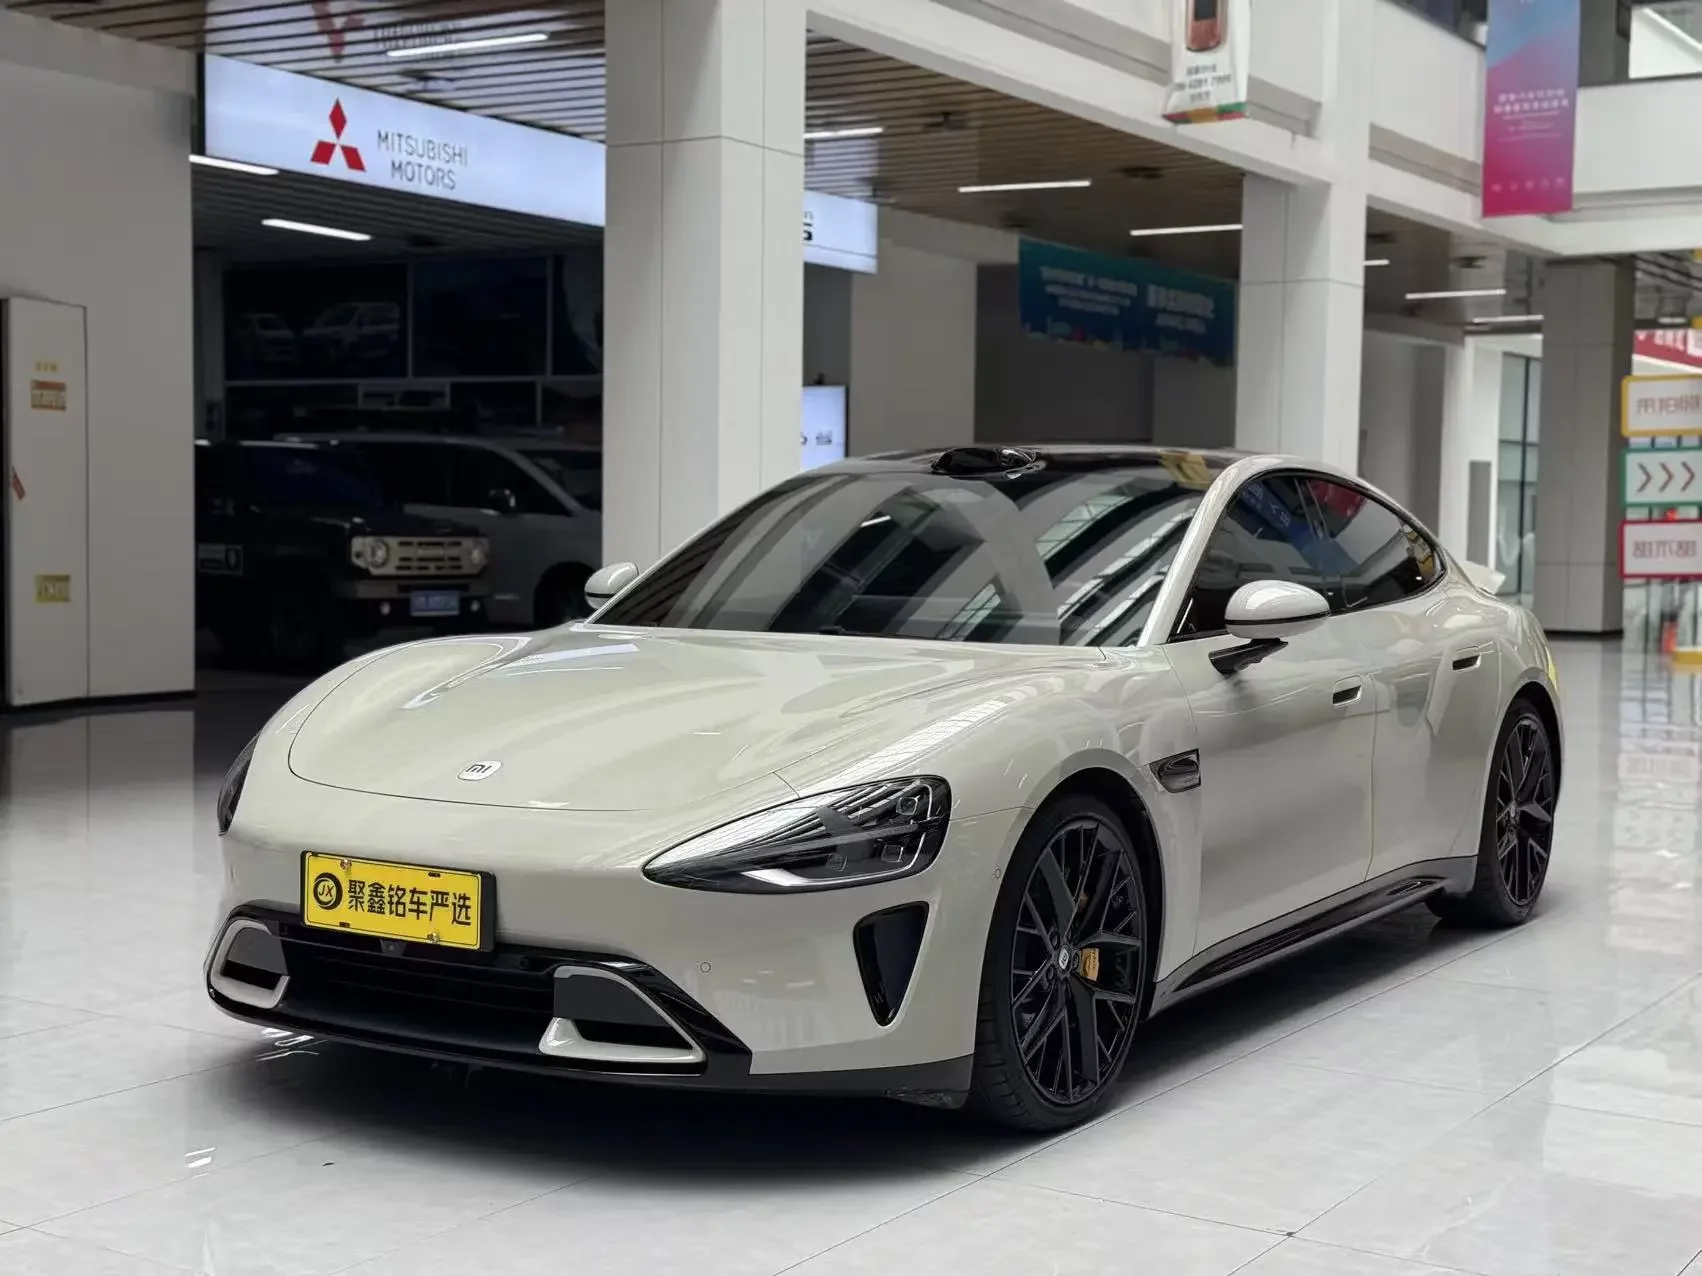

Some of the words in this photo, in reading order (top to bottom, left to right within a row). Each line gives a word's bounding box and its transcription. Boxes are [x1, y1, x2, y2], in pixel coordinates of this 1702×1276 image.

[377, 128, 468, 167] MITSUBISHI
[391, 159, 456, 190] MOTORS
[318, 883, 335, 899] JX
[347, 879, 472, 926] 聚鑫铭车严选
